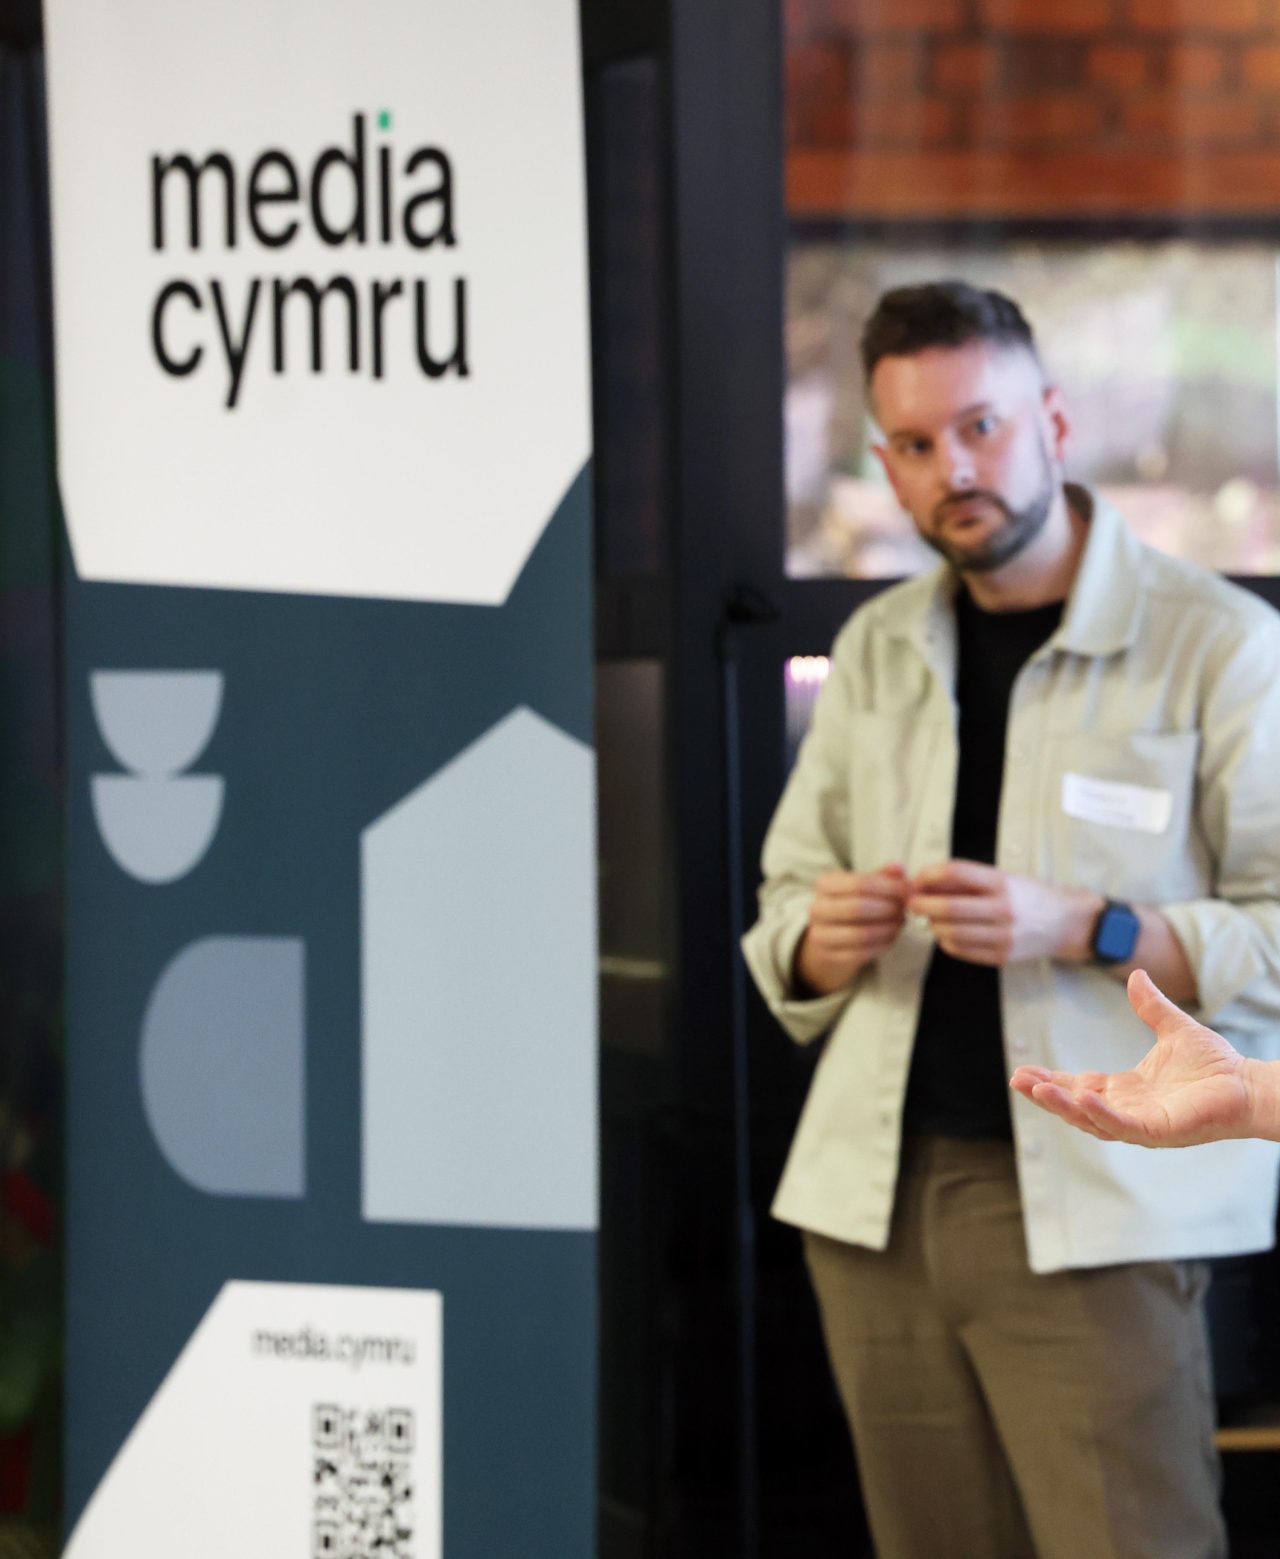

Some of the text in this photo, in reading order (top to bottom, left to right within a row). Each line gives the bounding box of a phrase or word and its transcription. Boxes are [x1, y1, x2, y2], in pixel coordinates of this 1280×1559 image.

[151, 110, 457, 253] media
[150, 273, 470, 411] cymru
[252, 1325, 416, 1370] media.cymru
